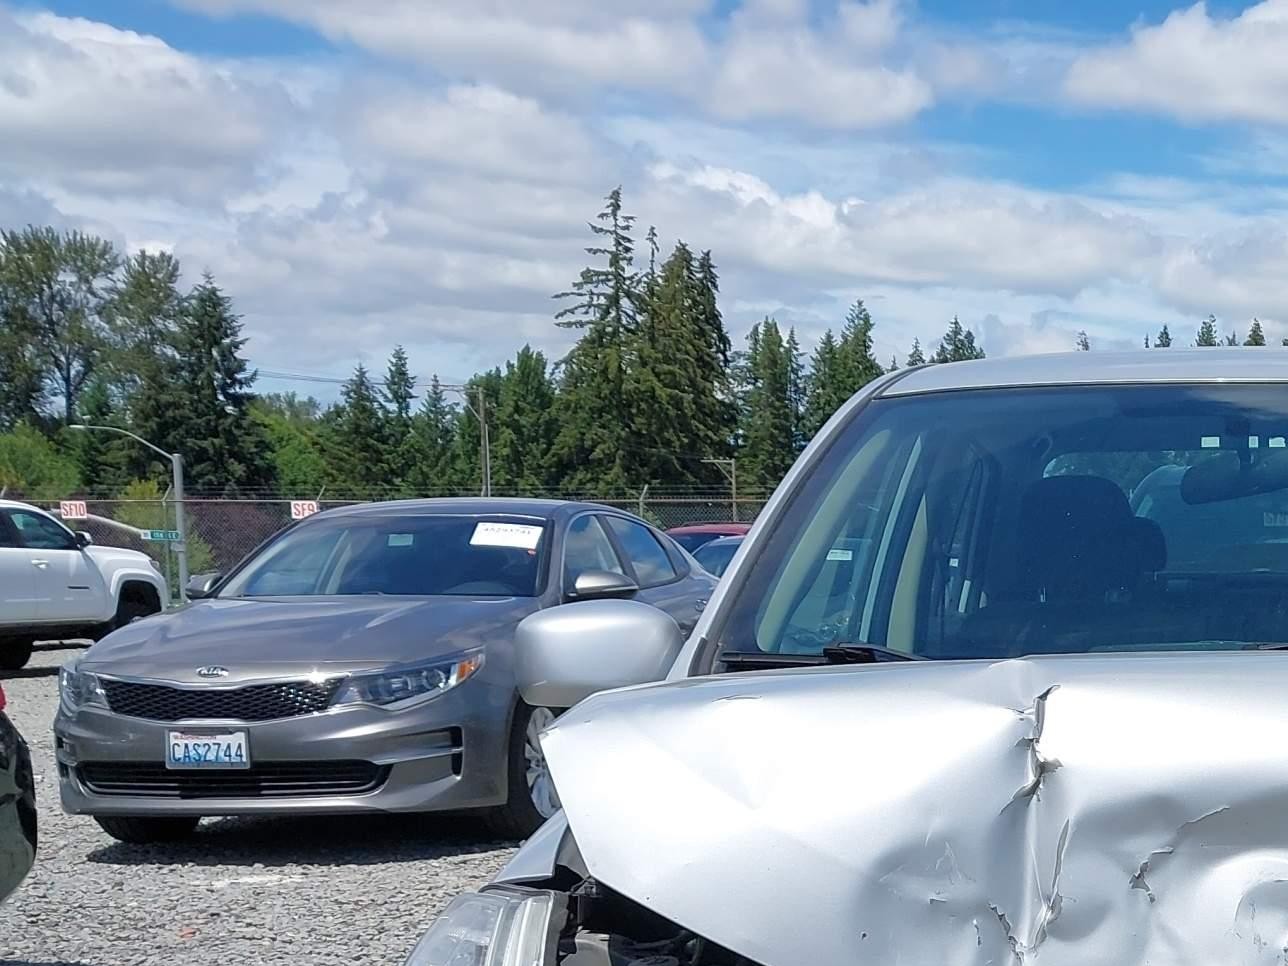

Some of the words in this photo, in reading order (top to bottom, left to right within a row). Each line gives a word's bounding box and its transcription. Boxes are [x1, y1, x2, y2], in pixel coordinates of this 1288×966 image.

[62, 502, 86, 517] SF10
[293, 503, 315, 516] SF9
[172, 742, 243, 762] CAS2744
